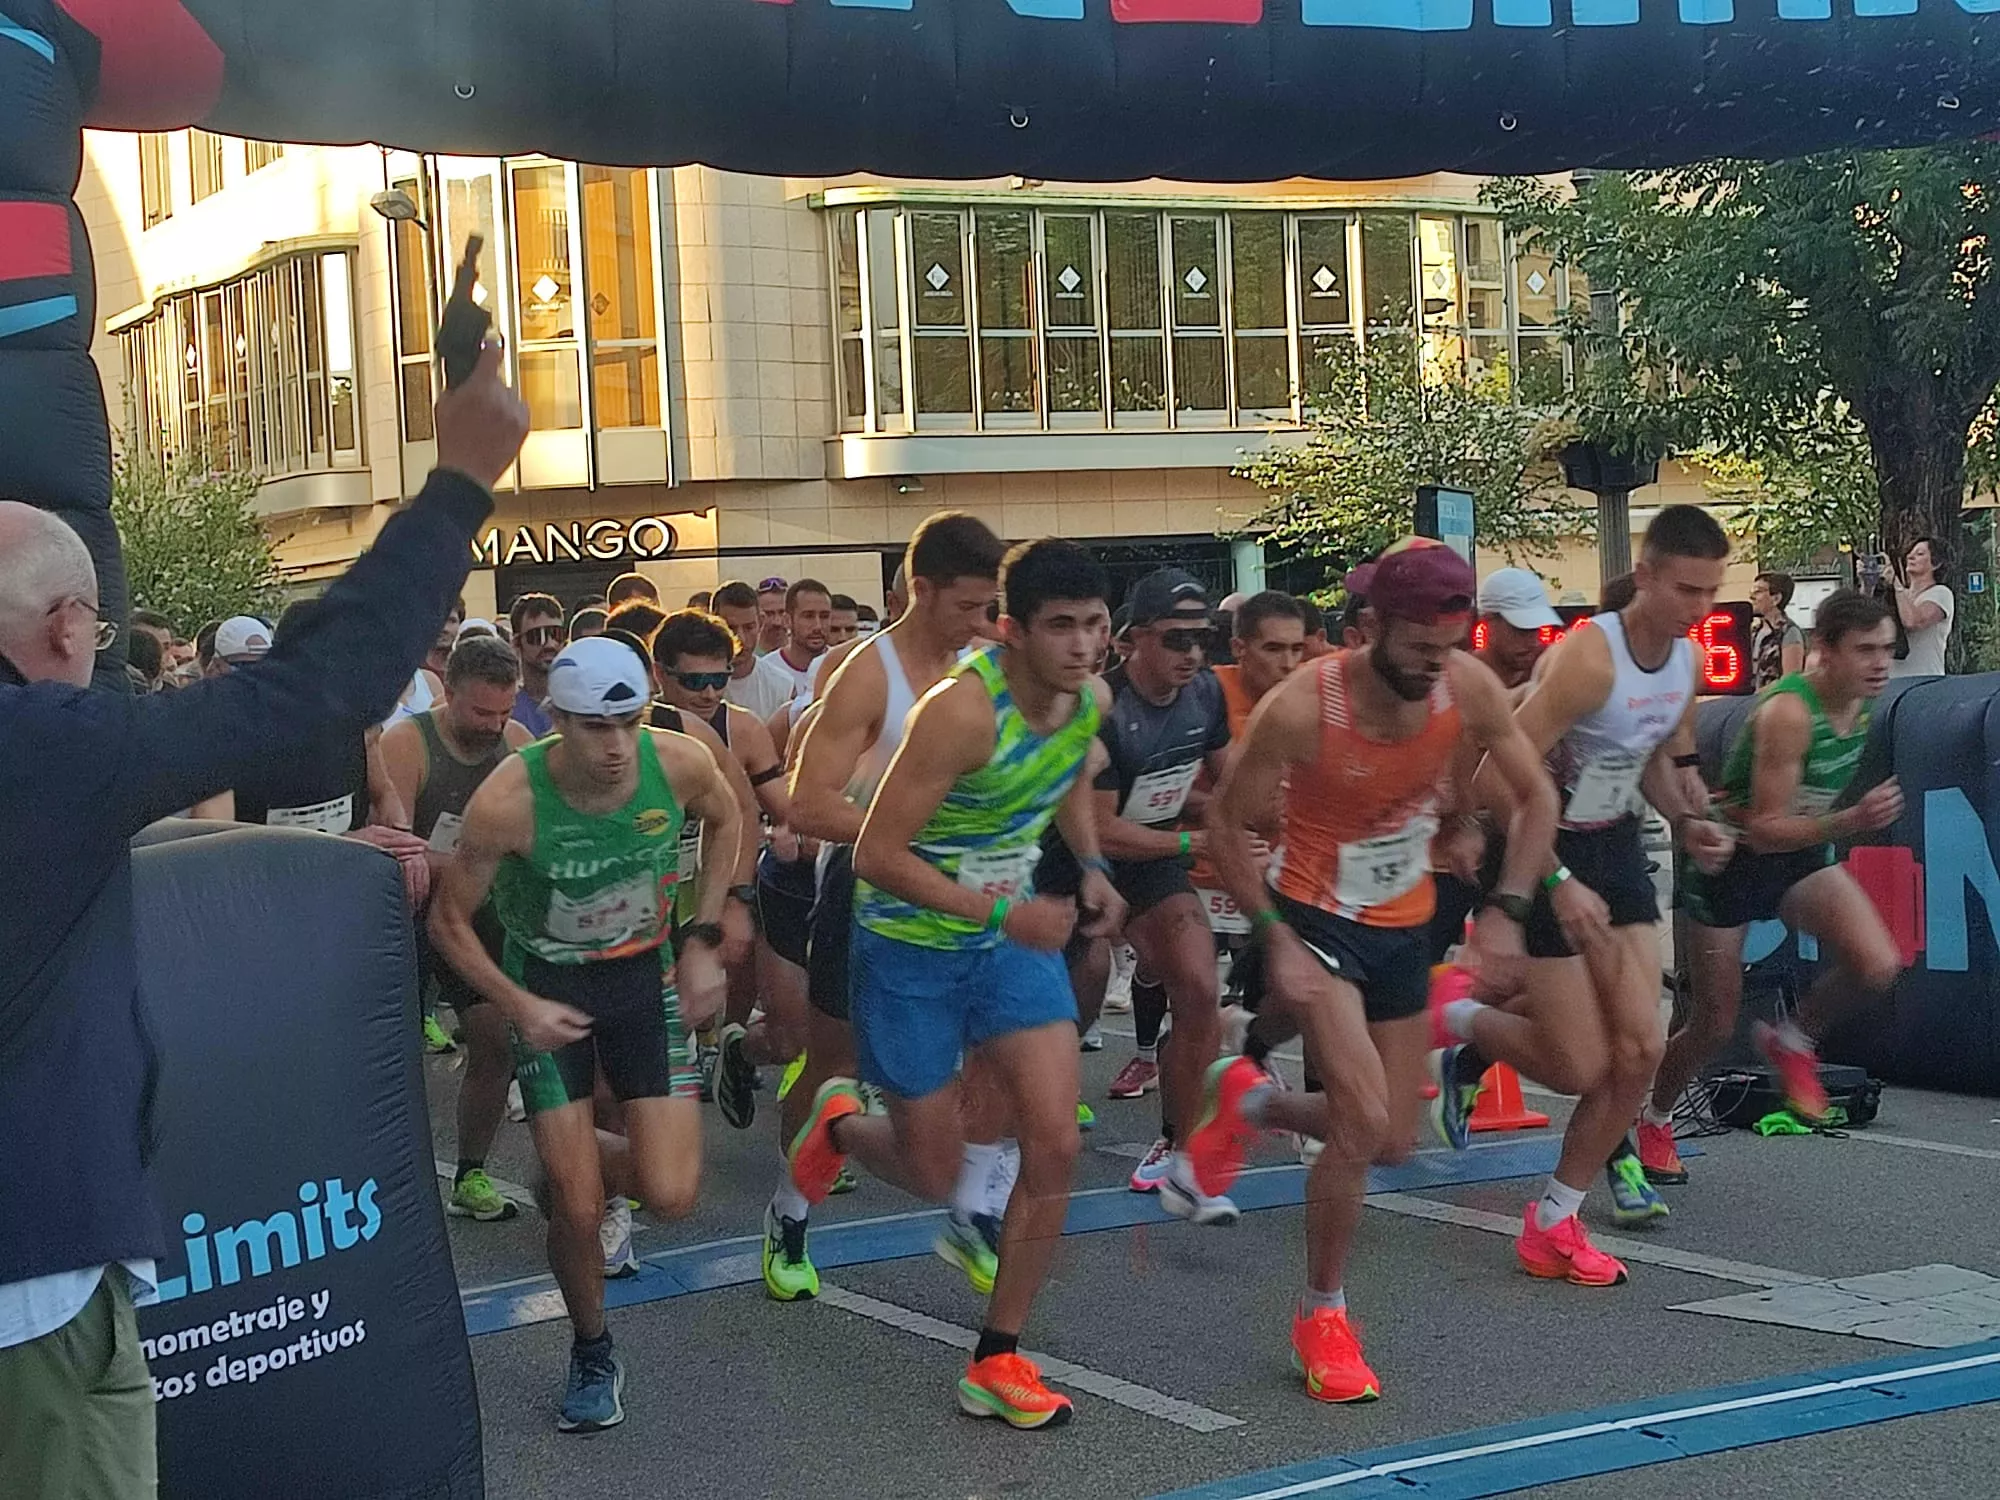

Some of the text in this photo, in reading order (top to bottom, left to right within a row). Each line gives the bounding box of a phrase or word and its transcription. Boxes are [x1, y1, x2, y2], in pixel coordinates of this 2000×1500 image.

[472, 517, 671, 566] MANGO
[311, 1289, 330, 1320] y
[205, 1319, 367, 1388] deportivos
